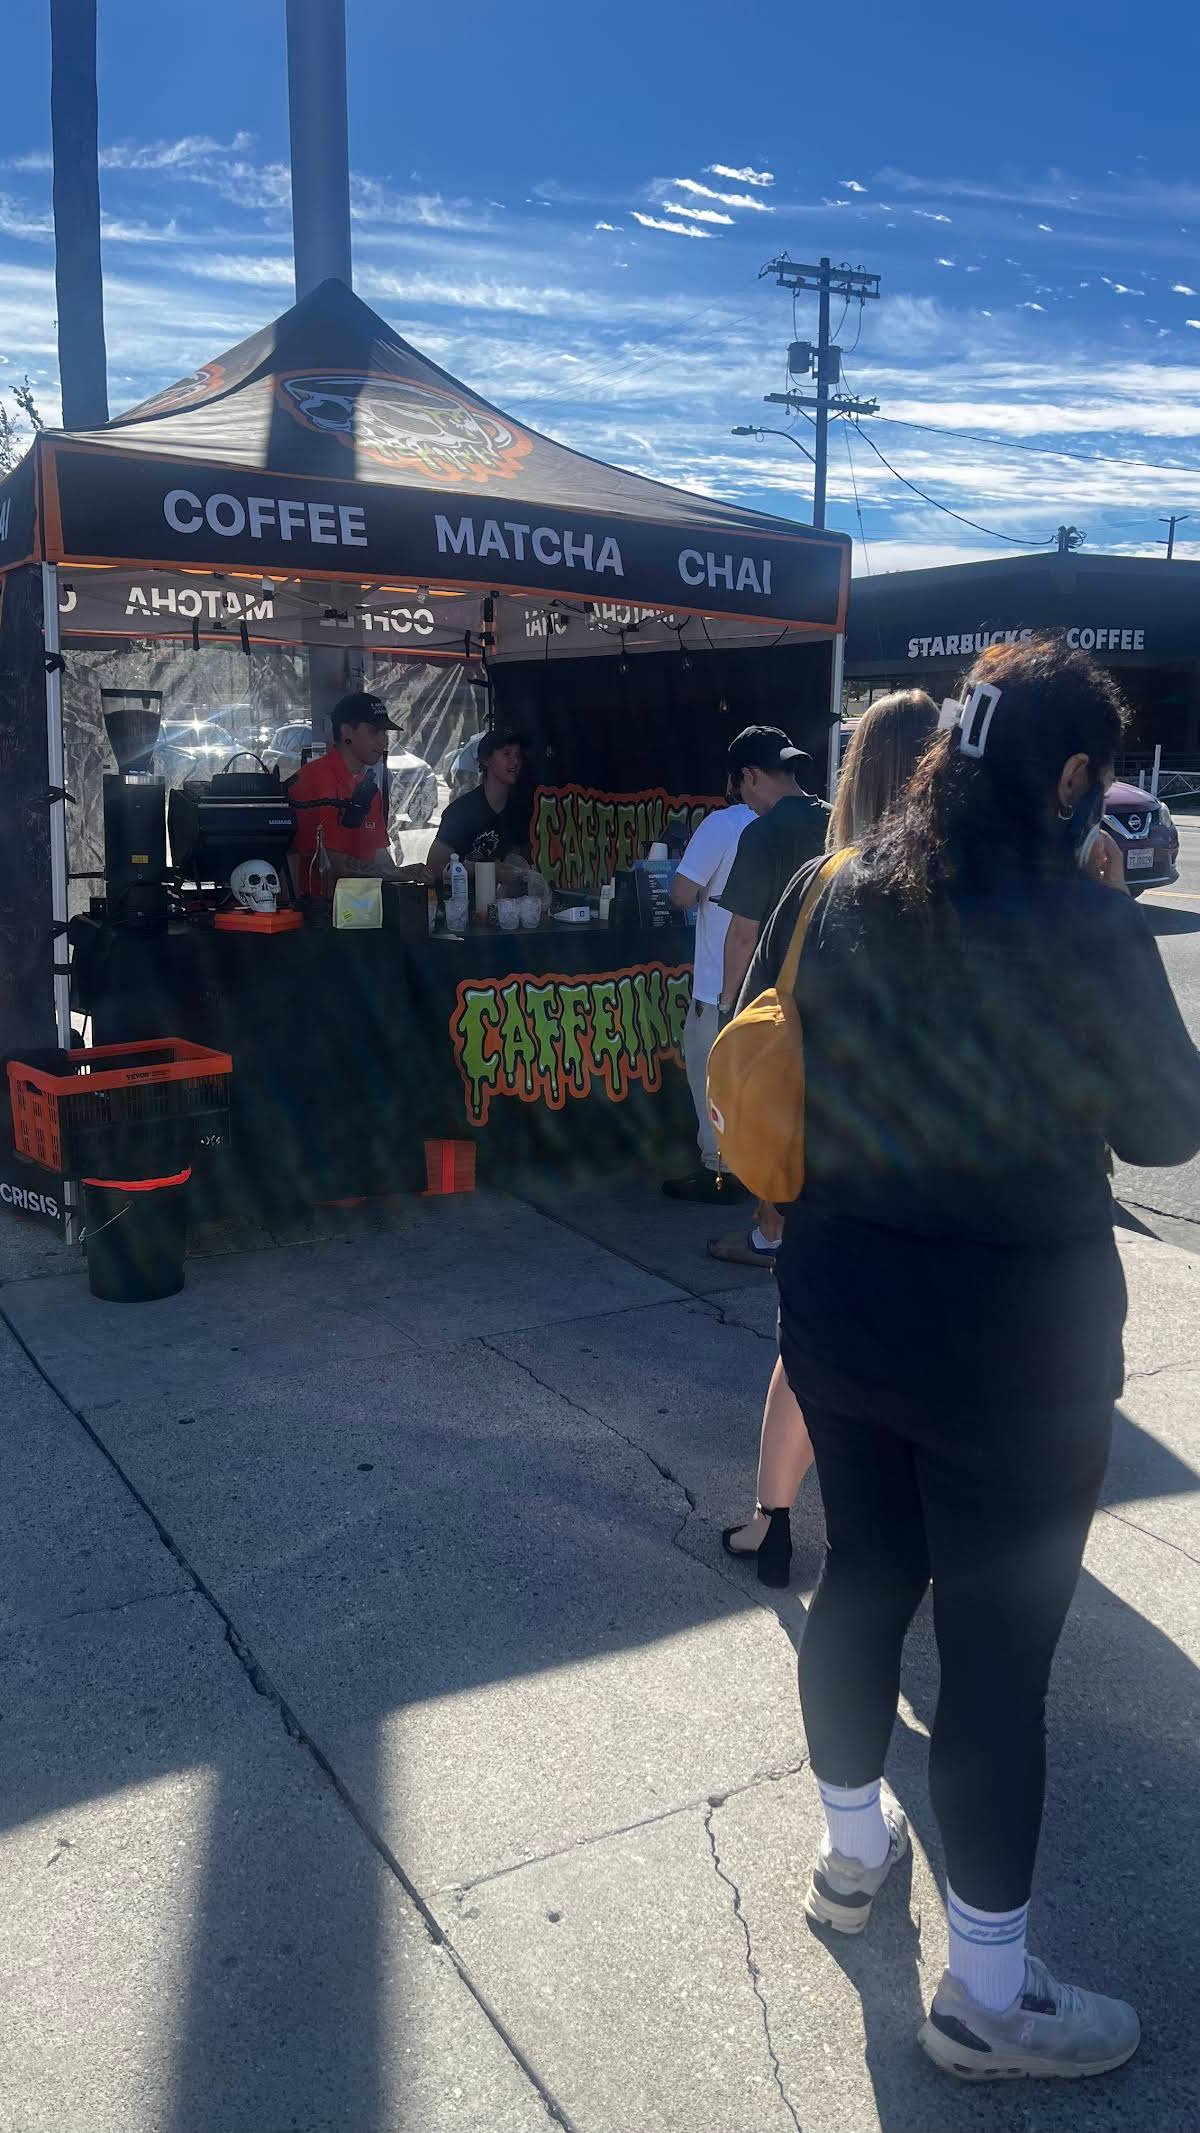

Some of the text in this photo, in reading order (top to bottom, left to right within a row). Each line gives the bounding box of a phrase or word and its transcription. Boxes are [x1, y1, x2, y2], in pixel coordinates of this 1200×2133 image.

[163, 489, 773, 595] COFFEE MATCHA CHAI
[1066, 627, 1145, 650] COFFEE
[455, 968, 692, 1116] CAFFEINE
